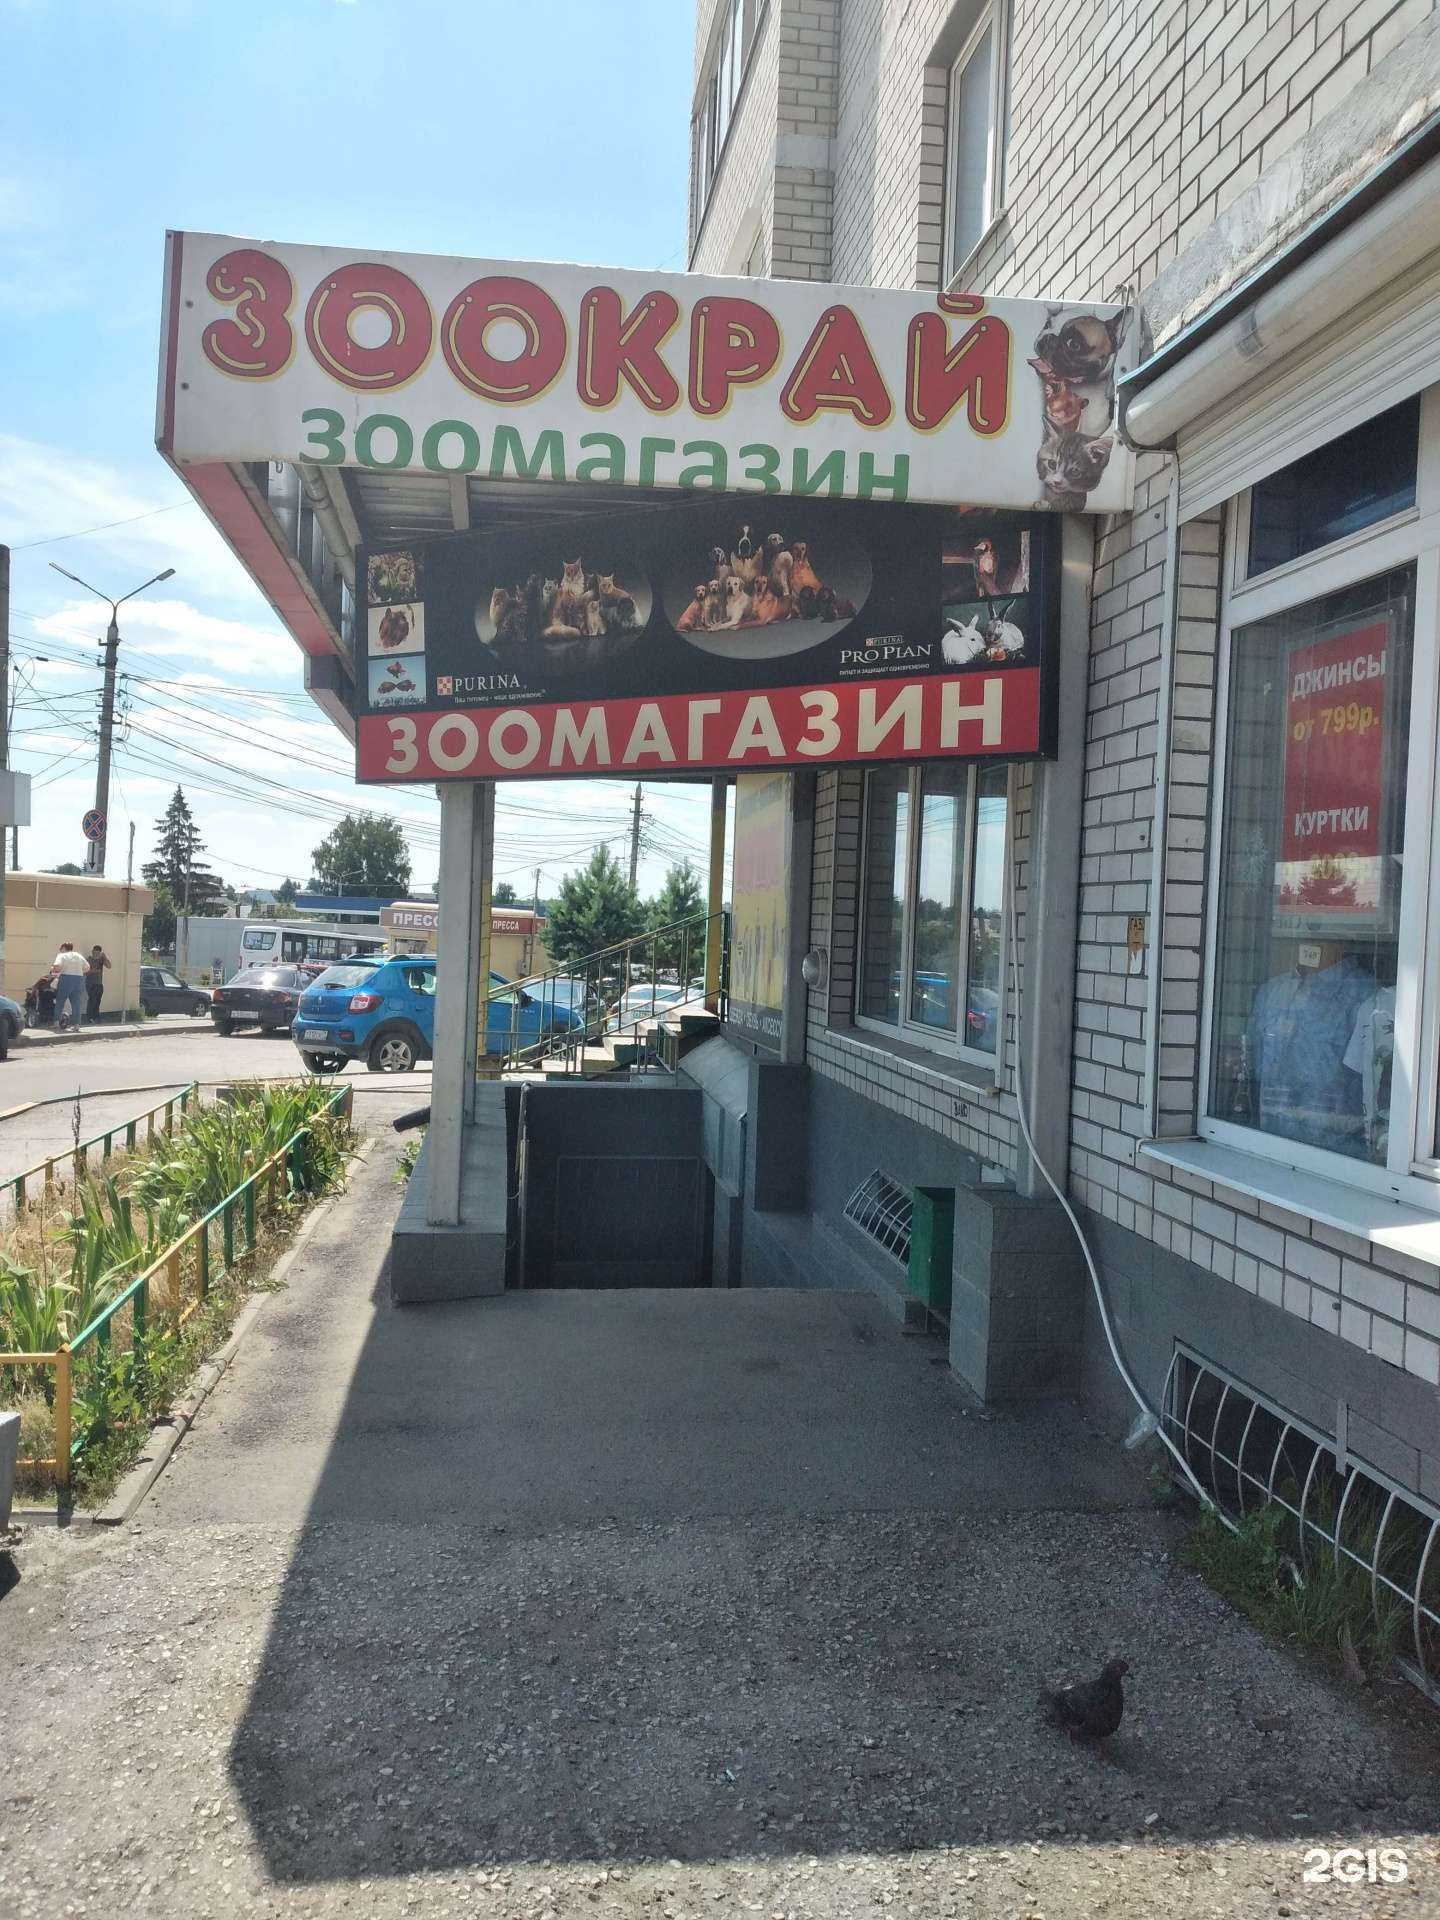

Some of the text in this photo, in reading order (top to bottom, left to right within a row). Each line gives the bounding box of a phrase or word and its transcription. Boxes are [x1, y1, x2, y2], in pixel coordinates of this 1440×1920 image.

[202, 249, 1013, 437] ЗООКРАЙ
[299, 407, 911, 502] зоомагазин
[840, 649, 879, 664] PRO
[1292, 650, 1387, 701] ДЖИНСЫ
[454, 674, 520, 692] PURINA
[385, 678, 1003, 773] ЗООМАГАЗИН
[1294, 806, 1369, 836] КУРТКИ
[492, 919, 520, 931] ПРЕССА
